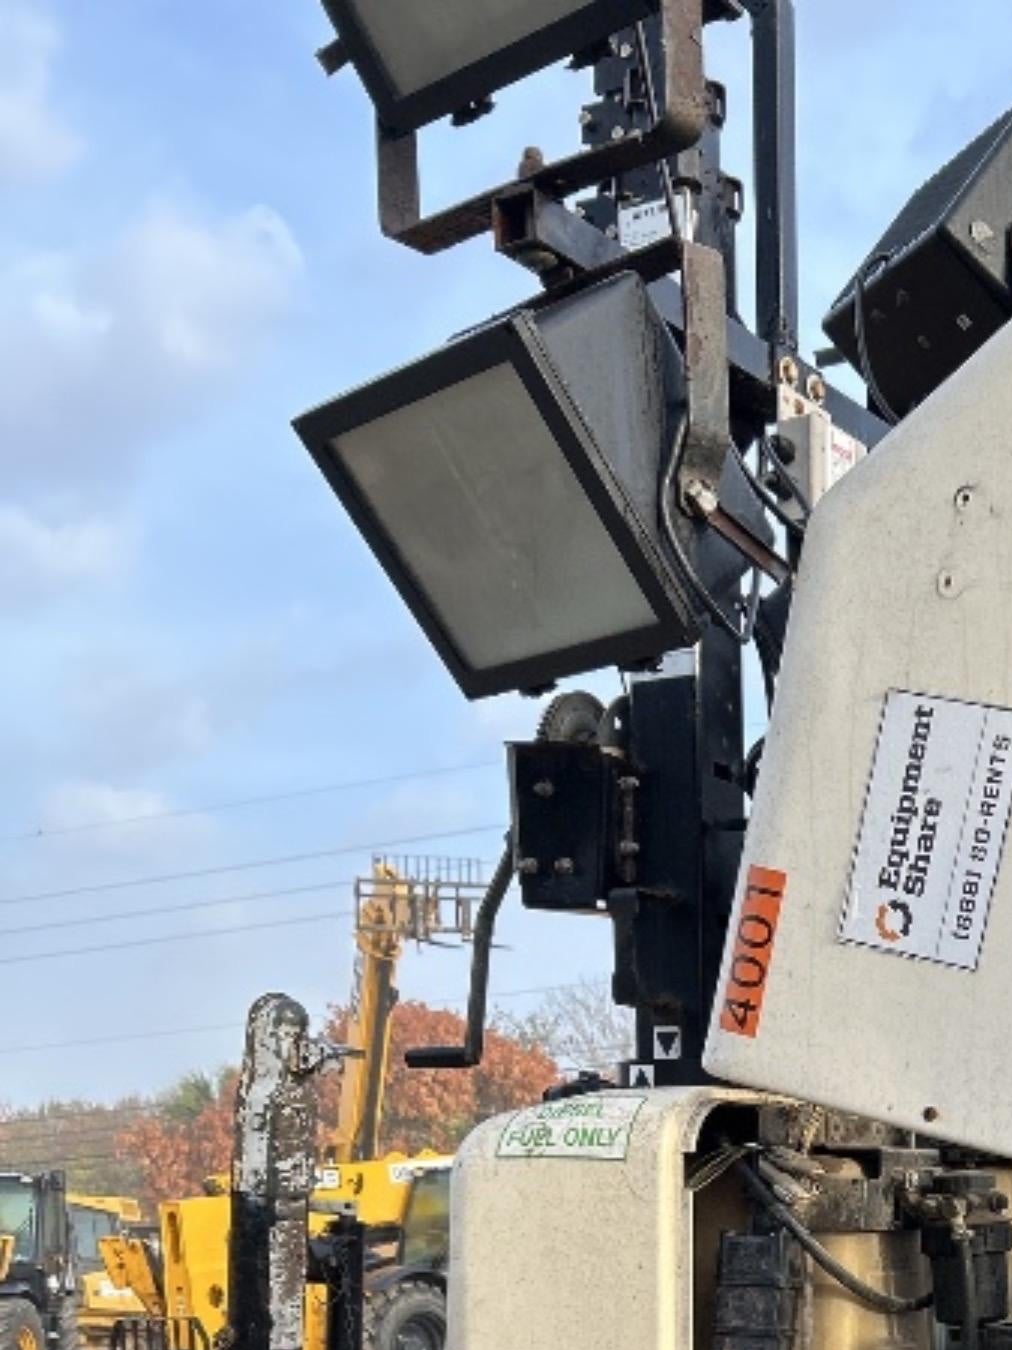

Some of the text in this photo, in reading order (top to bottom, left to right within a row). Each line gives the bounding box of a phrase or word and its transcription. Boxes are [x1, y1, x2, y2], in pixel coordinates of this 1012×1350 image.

[878, 705, 935, 892] Equipment
[902, 797, 942, 898] Share
[726, 883, 784, 1030] 4001
[506, 1126, 622, 1147] FUEL ONLY
